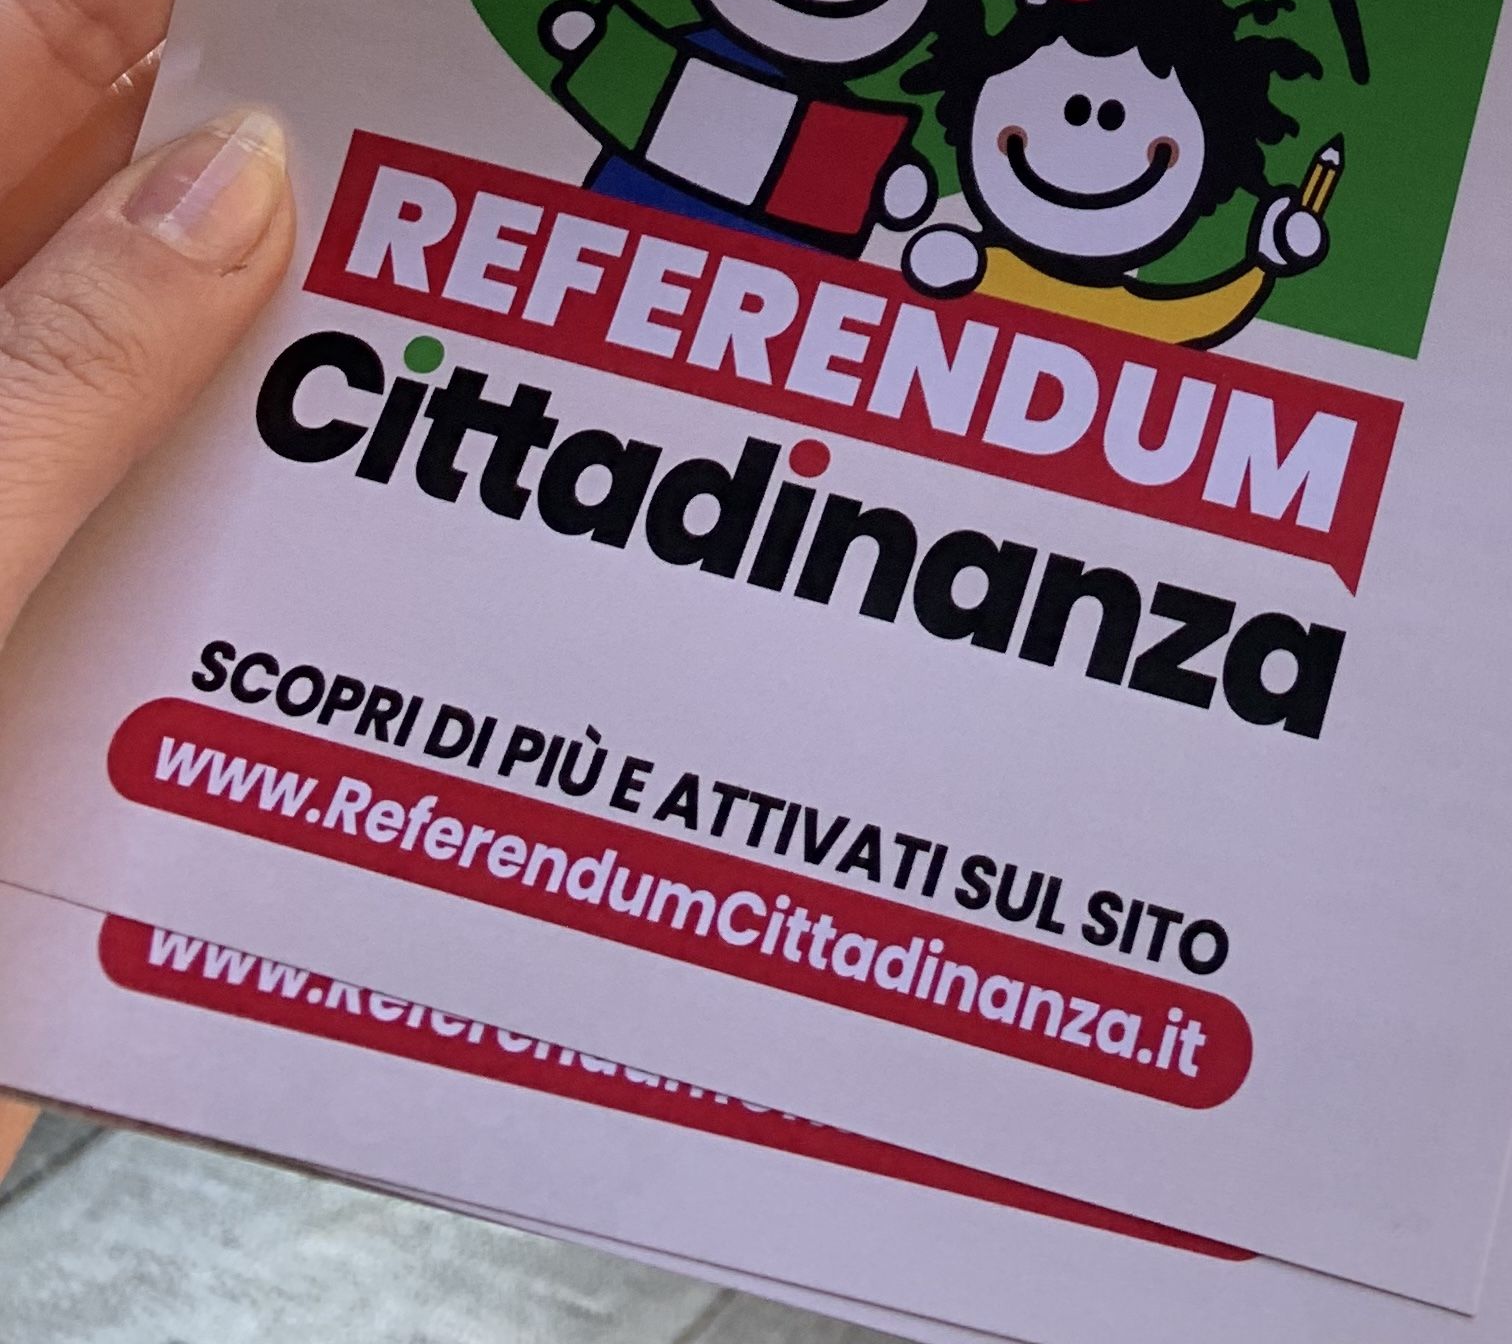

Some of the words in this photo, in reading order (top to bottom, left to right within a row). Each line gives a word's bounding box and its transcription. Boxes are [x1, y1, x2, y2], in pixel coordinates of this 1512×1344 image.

[345, 165, 1358, 533] REFERENDUM
[254, 330, 1347, 740] Cittadinanza
[154, 736, 1208, 1079] www.ReferendumCittadinanza.it
[191, 640, 424, 747] SCOPRI
[423, 703, 498, 769] DI
[497, 724, 609, 797] PIÙ
[609, 756, 655, 814] E
[652, 772, 949, 898] ATTIVATI
[954, 854, 1065, 935] SUL
[1081, 890, 1230, 976] SITO
